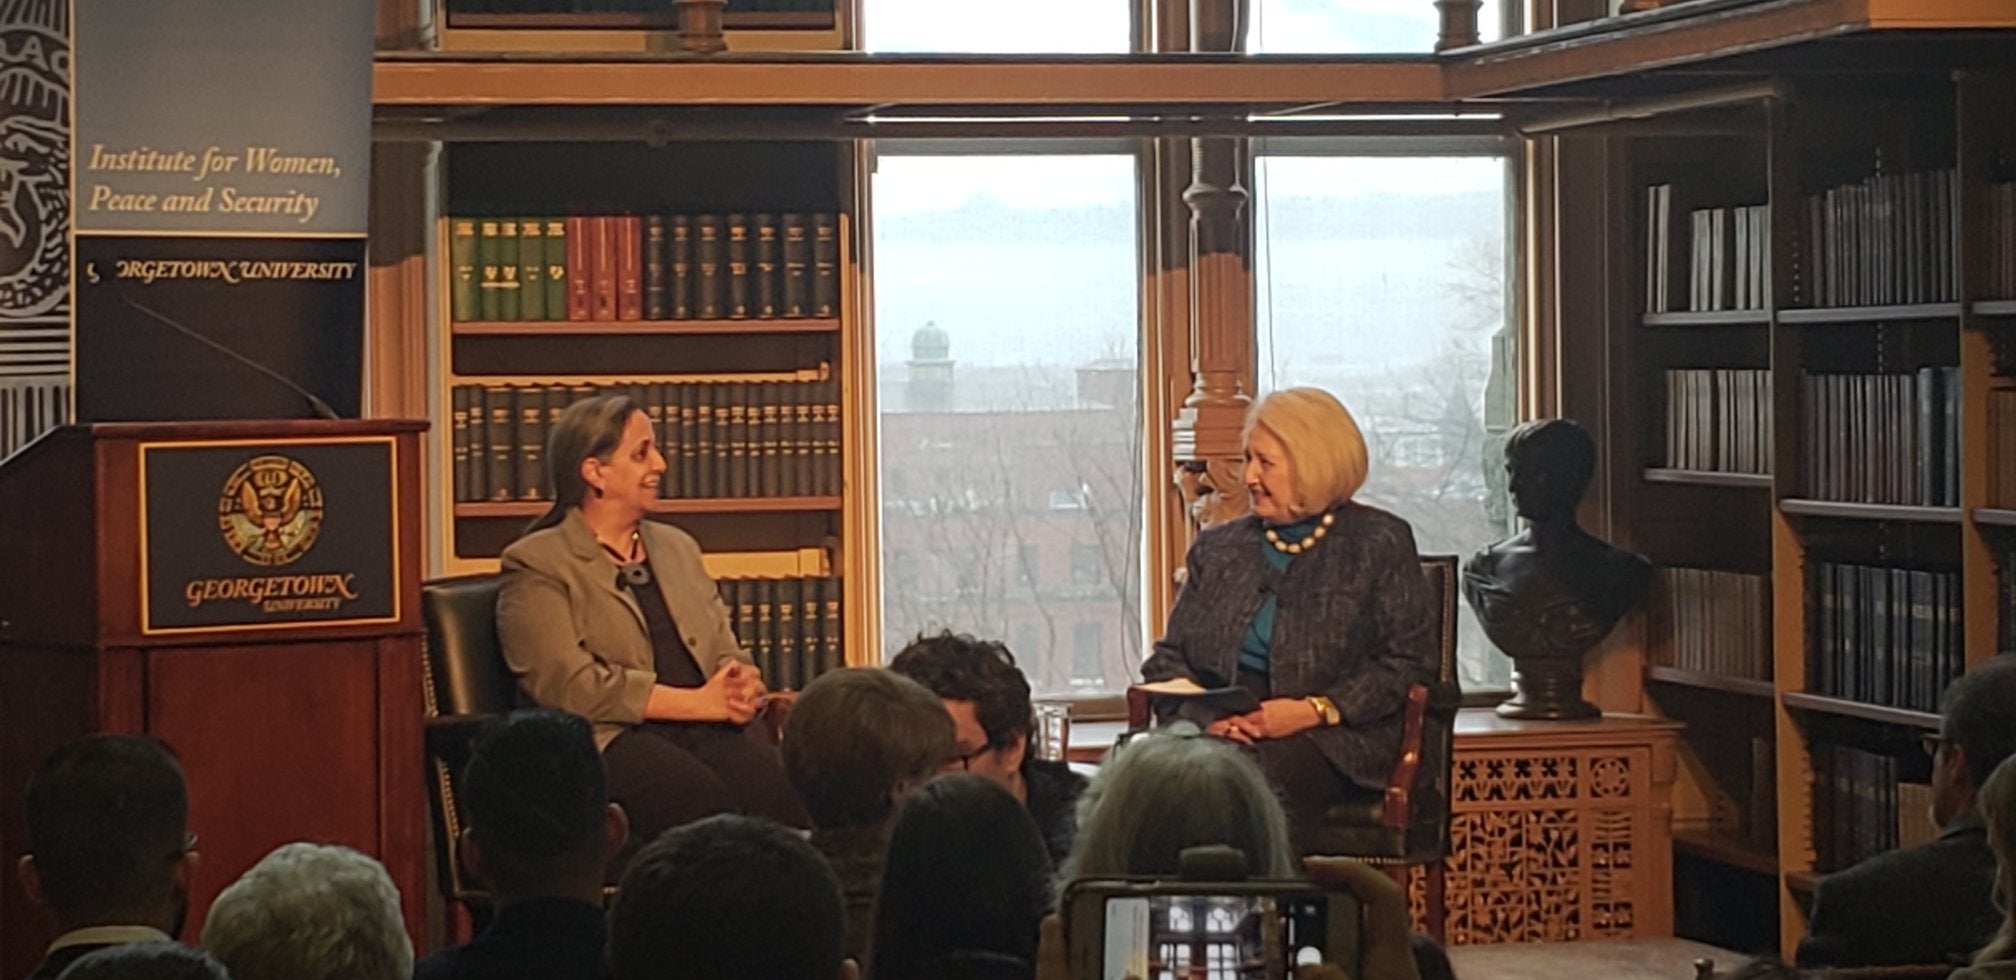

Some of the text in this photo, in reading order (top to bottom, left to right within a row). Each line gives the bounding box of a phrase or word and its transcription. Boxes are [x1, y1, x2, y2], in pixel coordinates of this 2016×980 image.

[89, 144, 342, 182] Institute for Women,
[89, 185, 319, 224] Peace and Security
[87, 259, 356, 285] GORGETOWN UNIVERSITY
[186, 573, 358, 608] GEORGETOWN
[263, 598, 342, 613] UNIVERSITY
